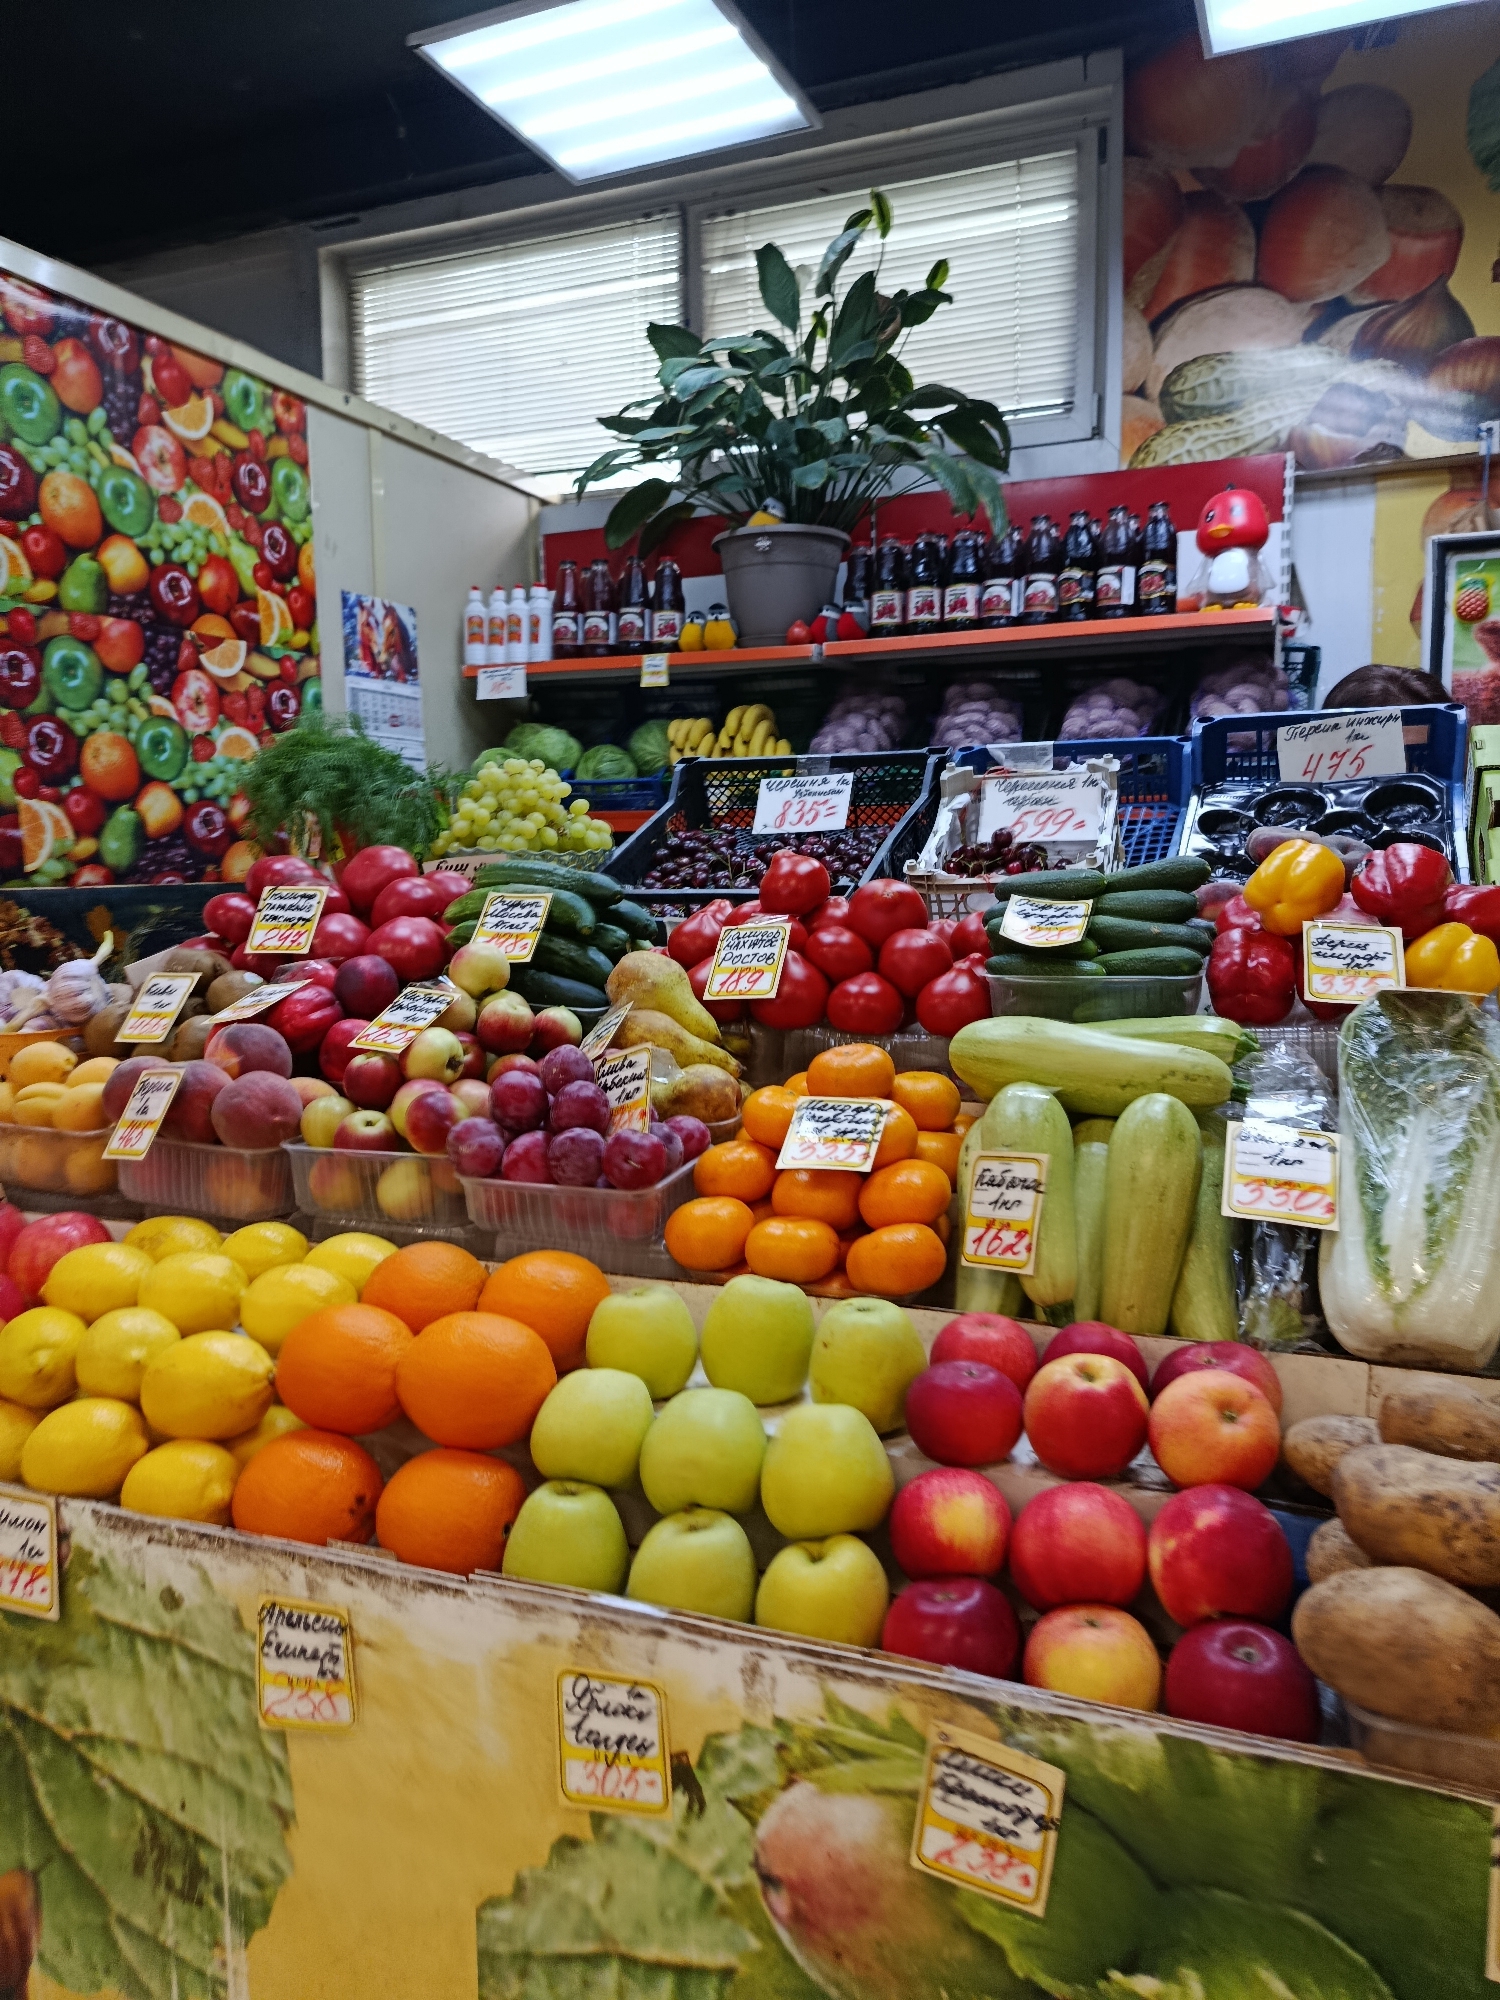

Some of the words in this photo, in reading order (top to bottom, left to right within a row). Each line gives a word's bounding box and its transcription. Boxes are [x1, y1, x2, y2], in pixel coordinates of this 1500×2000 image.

[1302, 744, 1374, 782] 475
[484, 907, 542, 919] Москва
[718, 951, 776, 967] РОСТОВ
[145, 982, 178, 996] Киви
[716, 967, 765, 996] 189
